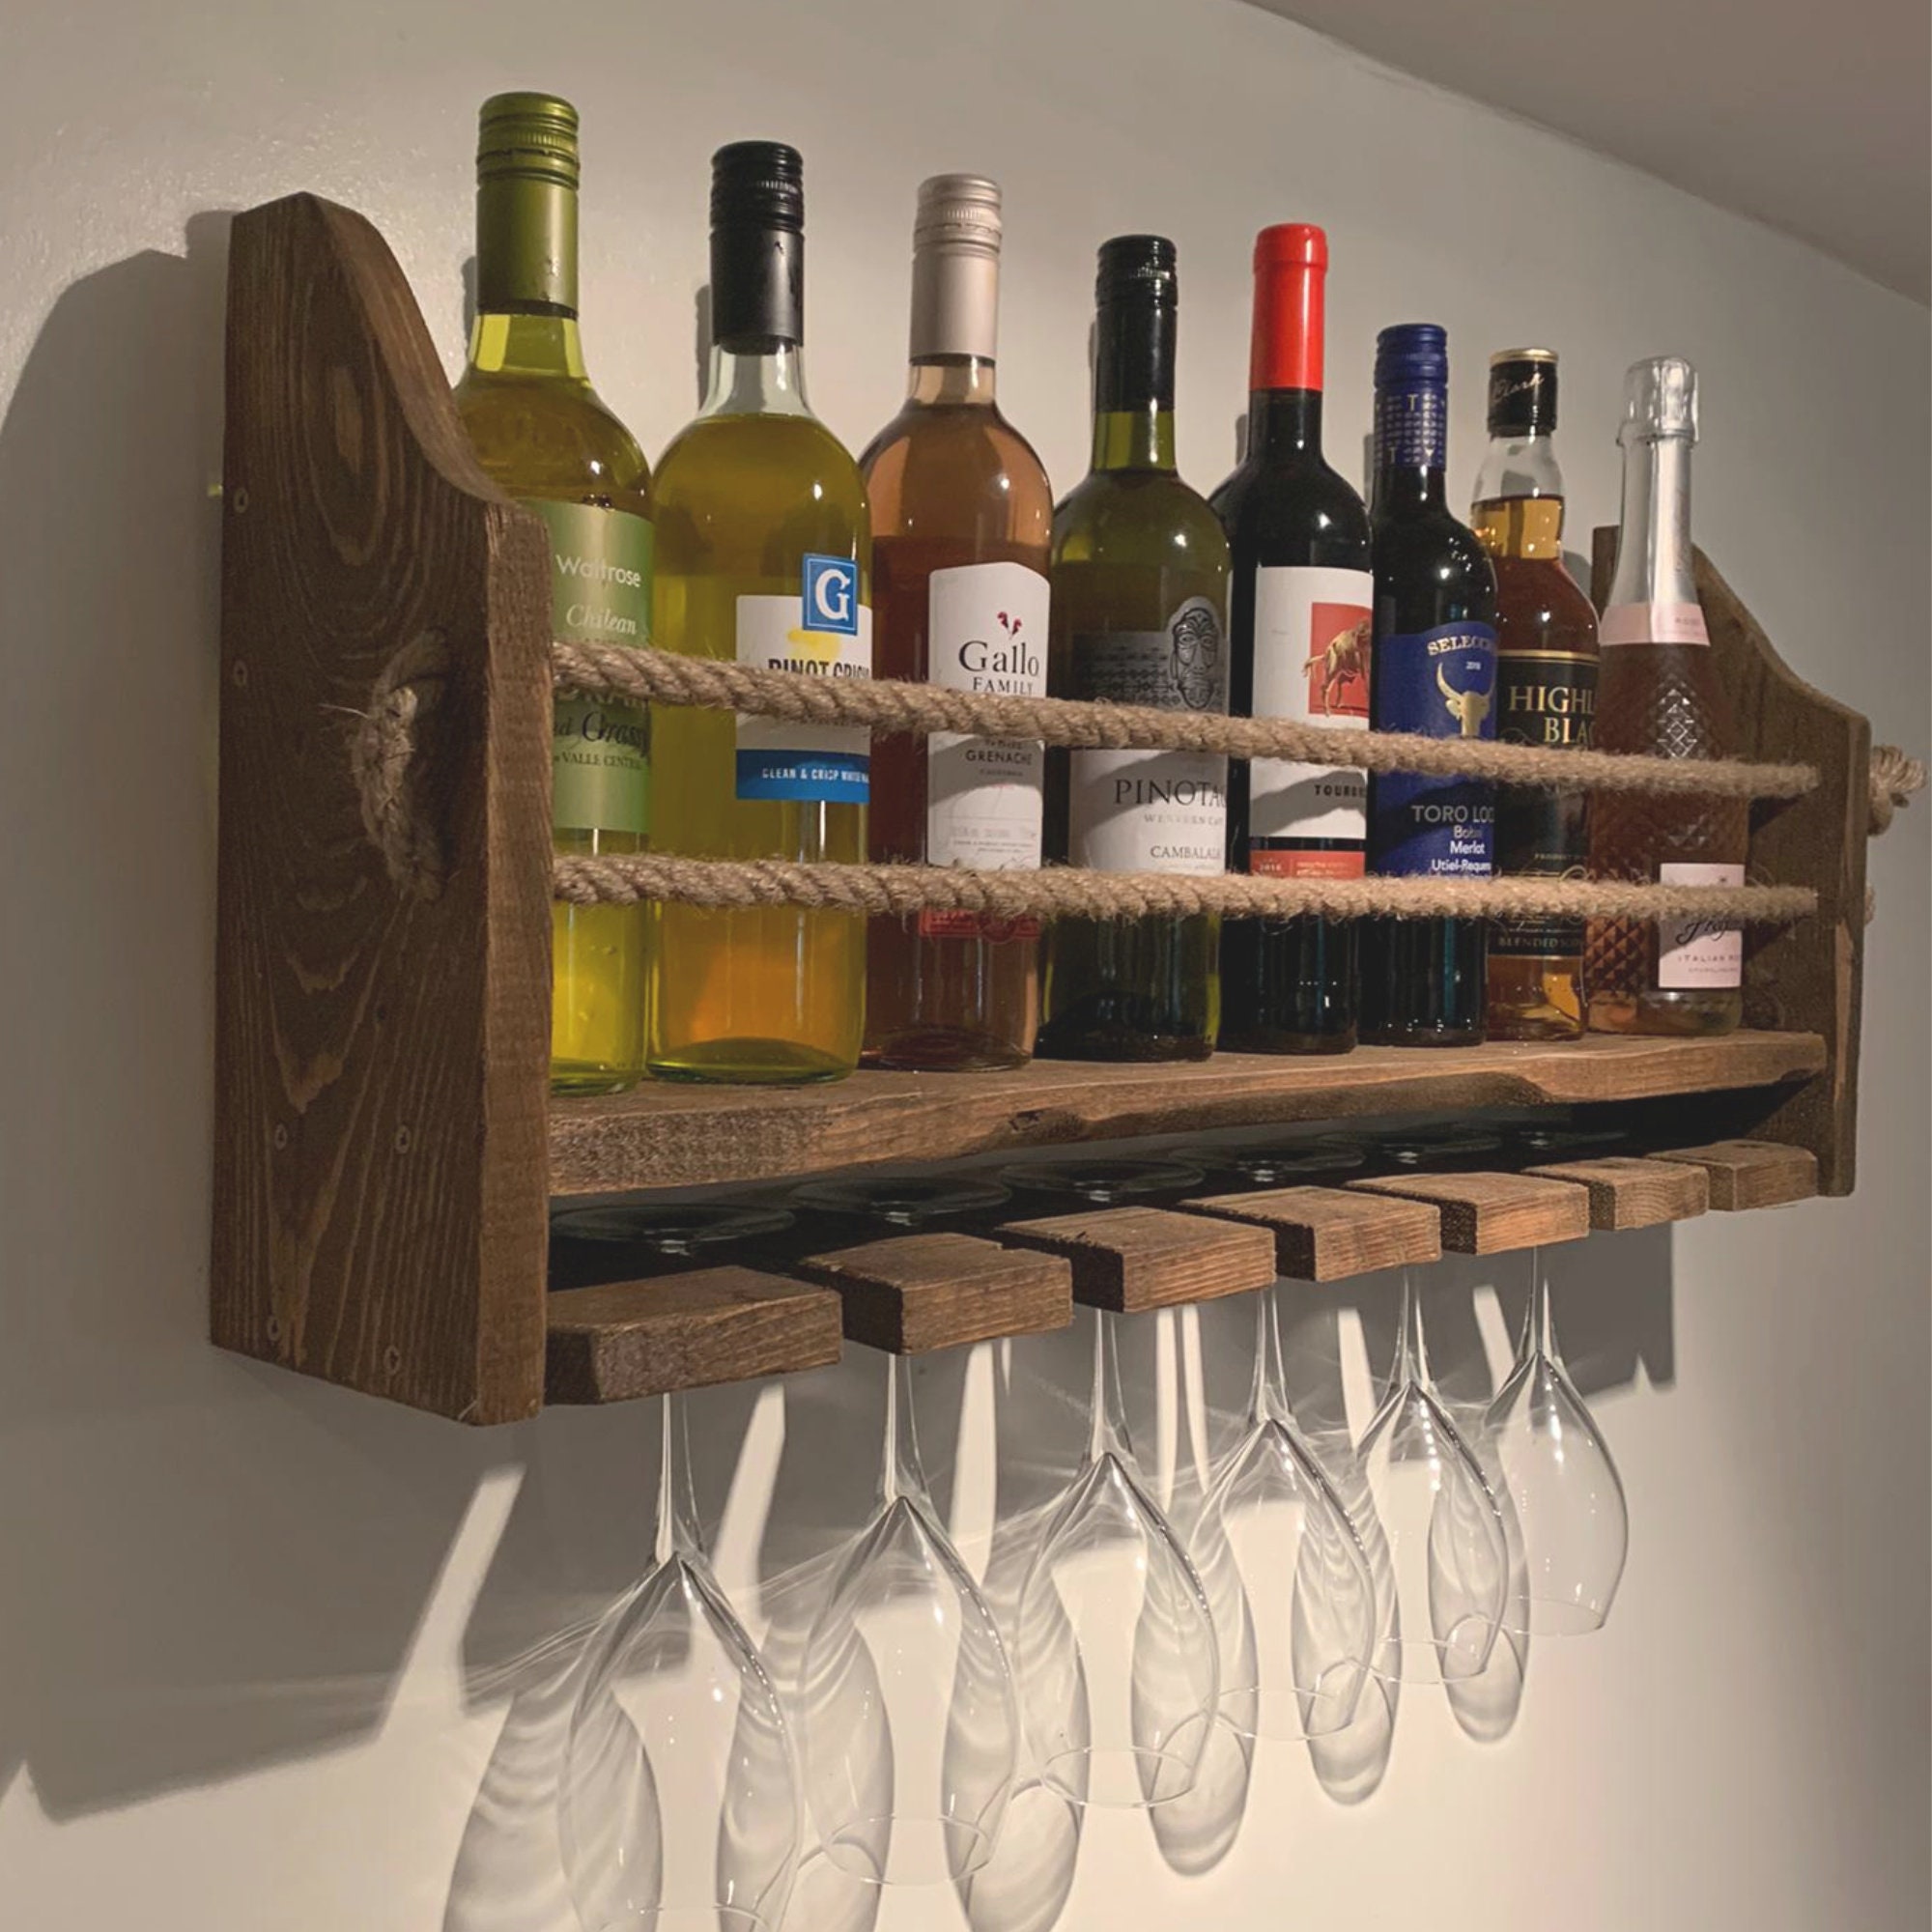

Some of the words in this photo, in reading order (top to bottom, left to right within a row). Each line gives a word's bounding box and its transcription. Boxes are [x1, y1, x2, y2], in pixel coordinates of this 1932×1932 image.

[554, 553, 641, 588] Waitrose
[814, 568, 851, 622] G
[566, 603, 638, 636] Chilean
[958, 639, 1039, 677] Gallo
[973, 676, 1034, 695] FAMILY
[965, 749, 1034, 766] GRENACHE
[762, 768, 797, 780] CLEAN
[800, 768, 809, 781] &
[811, 769, 840, 781] CRISP
[1411, 805, 1468, 823] TORO
[1450, 839, 1486, 855] Merlot
